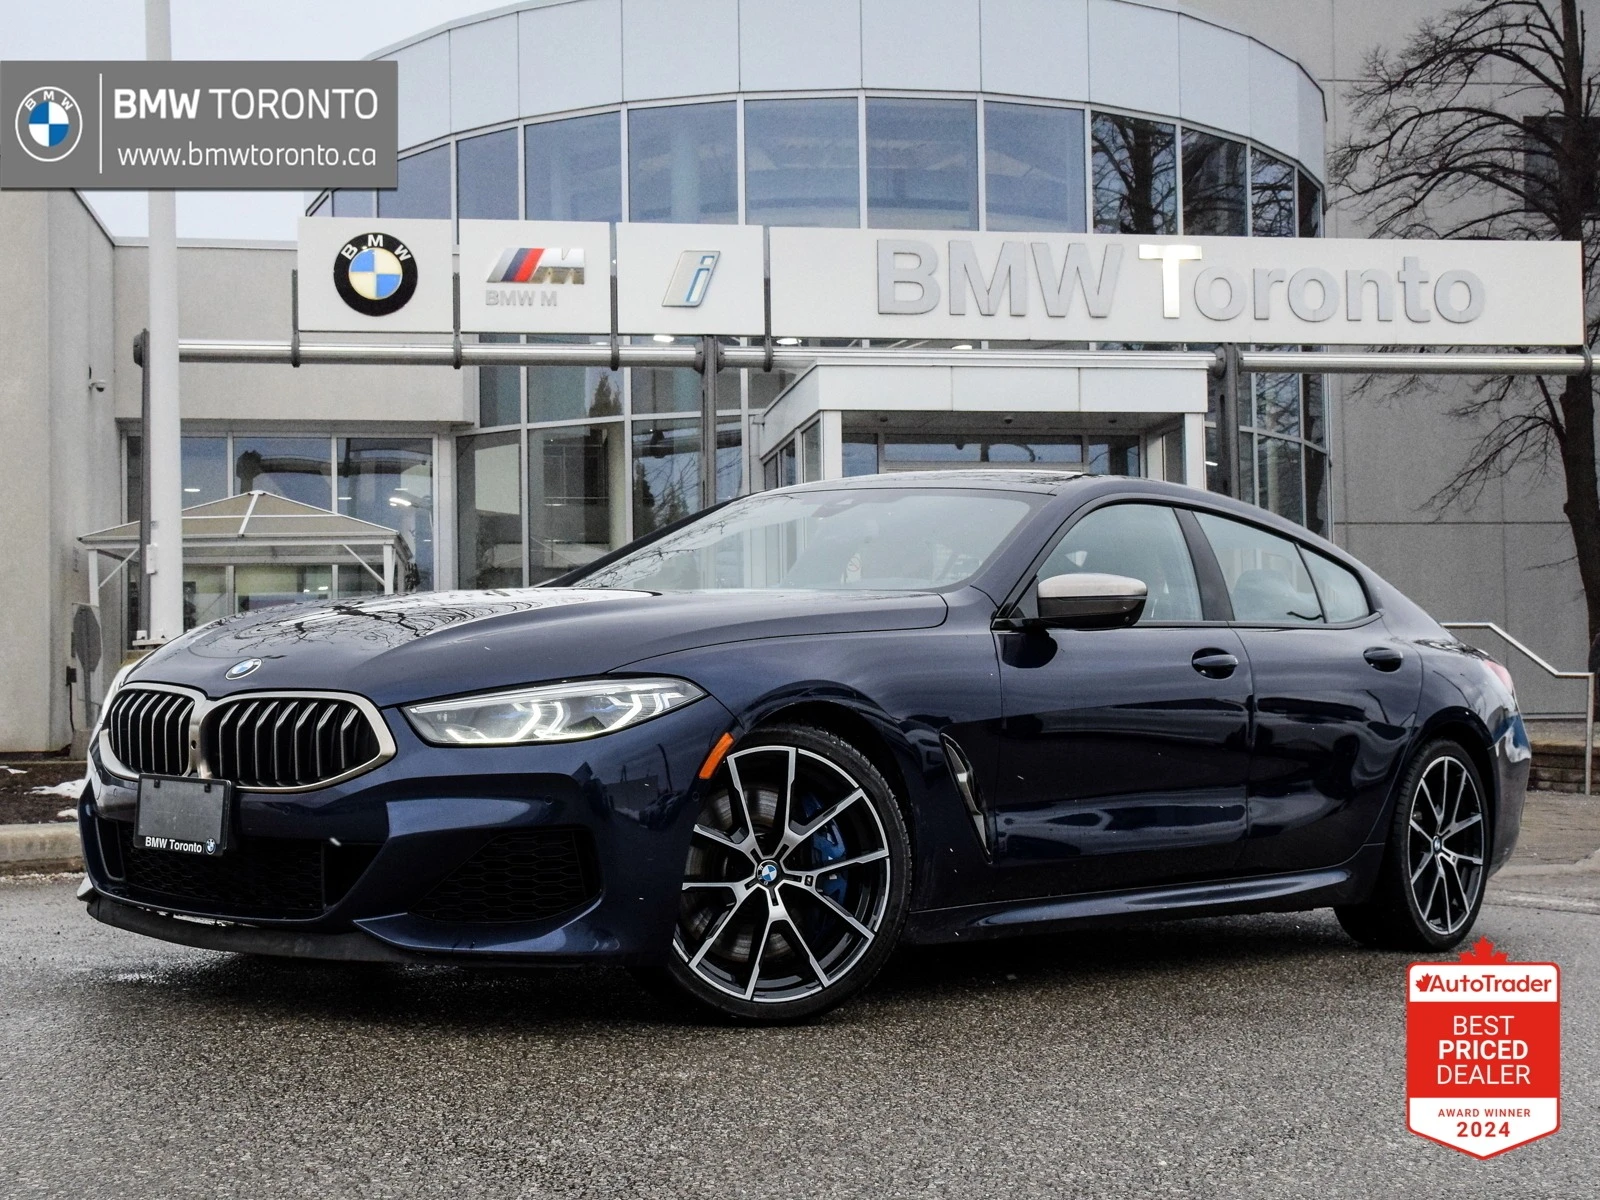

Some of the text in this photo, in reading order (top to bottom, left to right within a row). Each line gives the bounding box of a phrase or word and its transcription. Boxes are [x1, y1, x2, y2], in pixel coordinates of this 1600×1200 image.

[340, 233, 412, 261] BMW
[877, 239, 1486, 323] BMW Toronto
[485, 290, 558, 307] BMW M
[145, 836, 168, 848] BMW
[169, 839, 202, 853] Toronto
